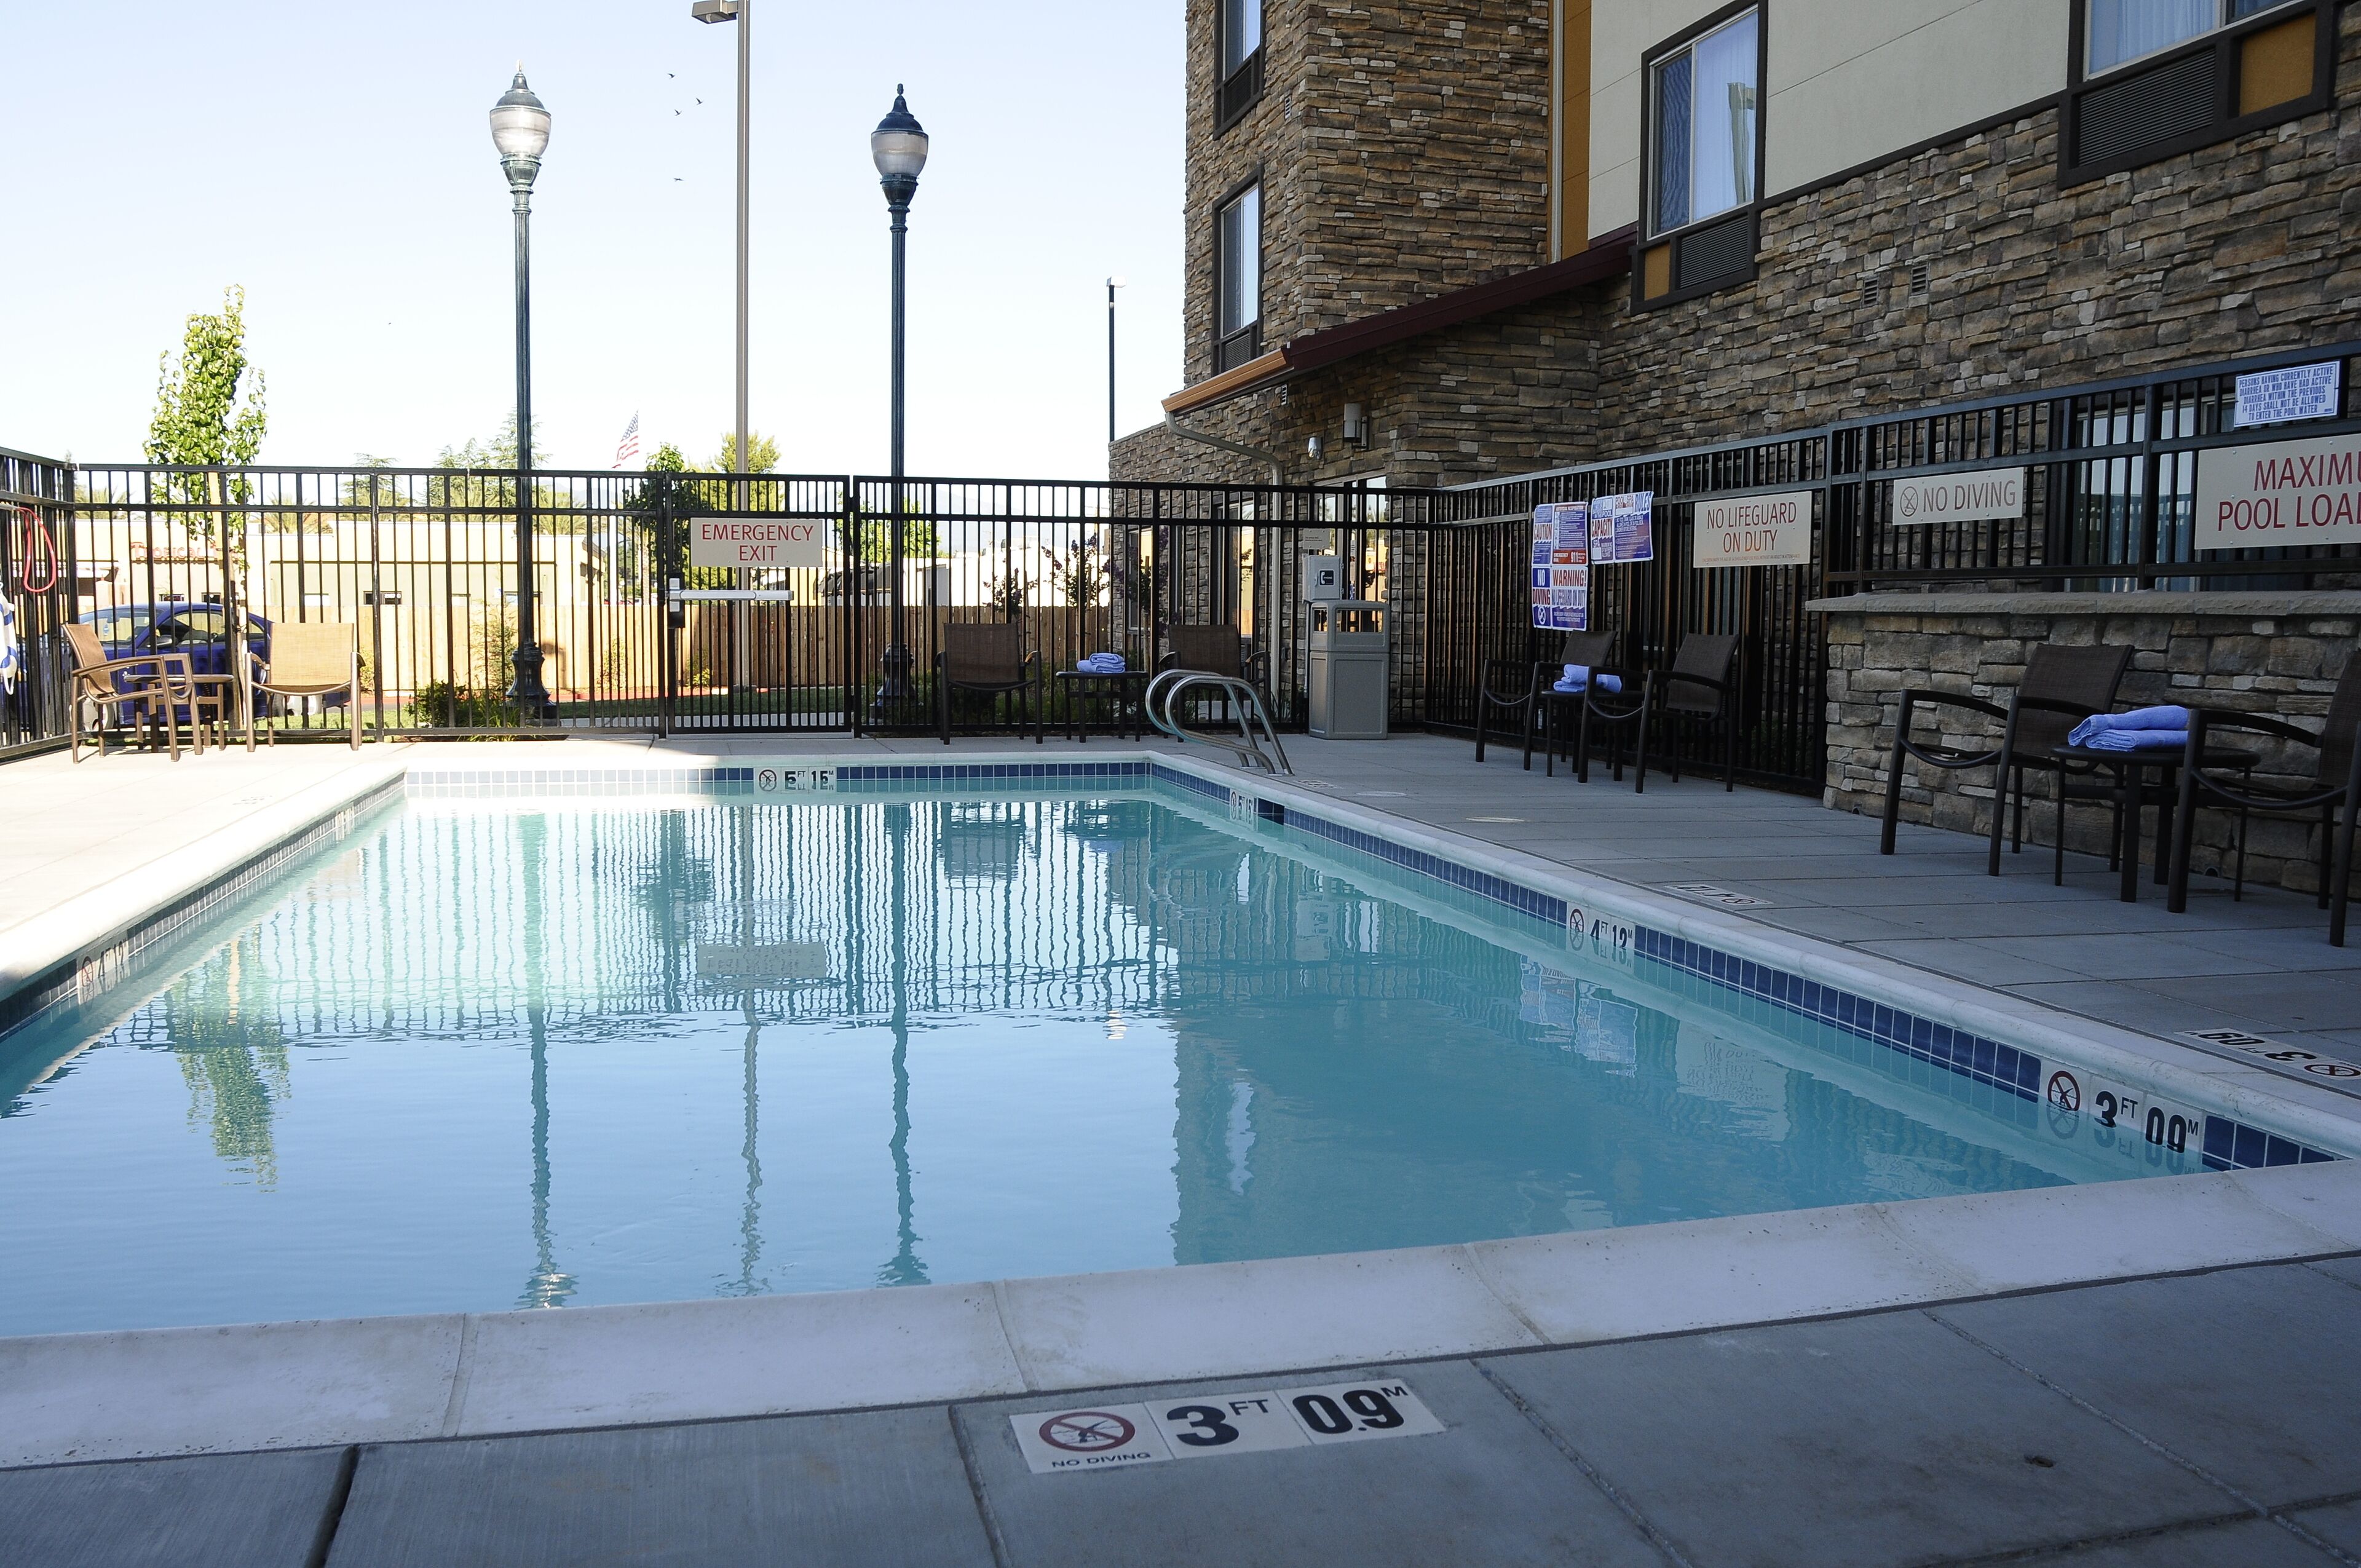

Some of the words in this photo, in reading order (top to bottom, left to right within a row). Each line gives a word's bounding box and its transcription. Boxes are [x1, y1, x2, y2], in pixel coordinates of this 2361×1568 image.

[2239, 377, 2260, 388] PERSONS
[2261, 375, 2279, 385] HAVING
[2280, 370, 2311, 382] CURRENTLY
[2313, 366, 2333, 376] ACTIVE
[2239, 386, 2262, 397] DIARRHEA
[2263, 384, 2269, 393] OR
[2272, 382, 2282, 392] WHO
[2284, 380, 2297, 390] HAVE
[2299, 379, 2310, 388] HAD
[2311, 375, 2331, 386] ACTIVE
[2244, 394, 2266, 405] DIARRHEA
[2268, 391, 2286, 401] WITHIN
[2288, 389, 2297, 398] THE
[2299, 386, 2326, 397] PREVIOUS
[2249, 403, 2262, 412] DAYS
[2263, 400, 2278, 410] SHALL
[2280, 398, 2290, 408] NOT
[2292, 397, 2299, 406] BE
[2301, 394, 2326, 405] ALLOWED
[2256, 410, 2271, 420] ENTER
[2273, 408, 2282, 418] THE
[2284, 407, 2296, 416] POOL
[2299, 405, 2318, 415] WATER
[1635, 493, 1651, 512] RULES
[1923, 486, 1948, 512] NO
[1954, 480, 2016, 510] DIVING
[1707, 508, 1724, 529] NO
[1728, 501, 1797, 528] LIFEGUARD
[2218, 497, 2286, 531] POOL
[2296, 492, 2361, 528] LOA
[702, 524, 814, 541] EMERGENCY
[1534, 523, 1552, 540] CAUTION
[1592, 518, 1613, 537] CAPACITY
[1723, 532, 1741, 553] ON
[1745, 529, 1778, 552] DUTY
[739, 545, 778, 561] EXIT
[1538, 569, 1545, 586] NO
[1553, 569, 1586, 587] WARNING!
[1533, 588, 1551, 605] DIVING
[1601, 921, 1608, 934] FT
[2264, 1051, 2317, 1061] 3
[2094, 1090, 2118, 1128] 3
[2121, 1097, 2138, 1119] FT
[2188, 1119, 2199, 1136] M
[1166, 1405, 1240, 1447] 3
[1228, 1399, 1268, 1416] FT
[1292, 1389, 1405, 1435] 0.9
[1380, 1386, 1409, 1398] M
[1087, 1452, 1151, 1464] DIVING
